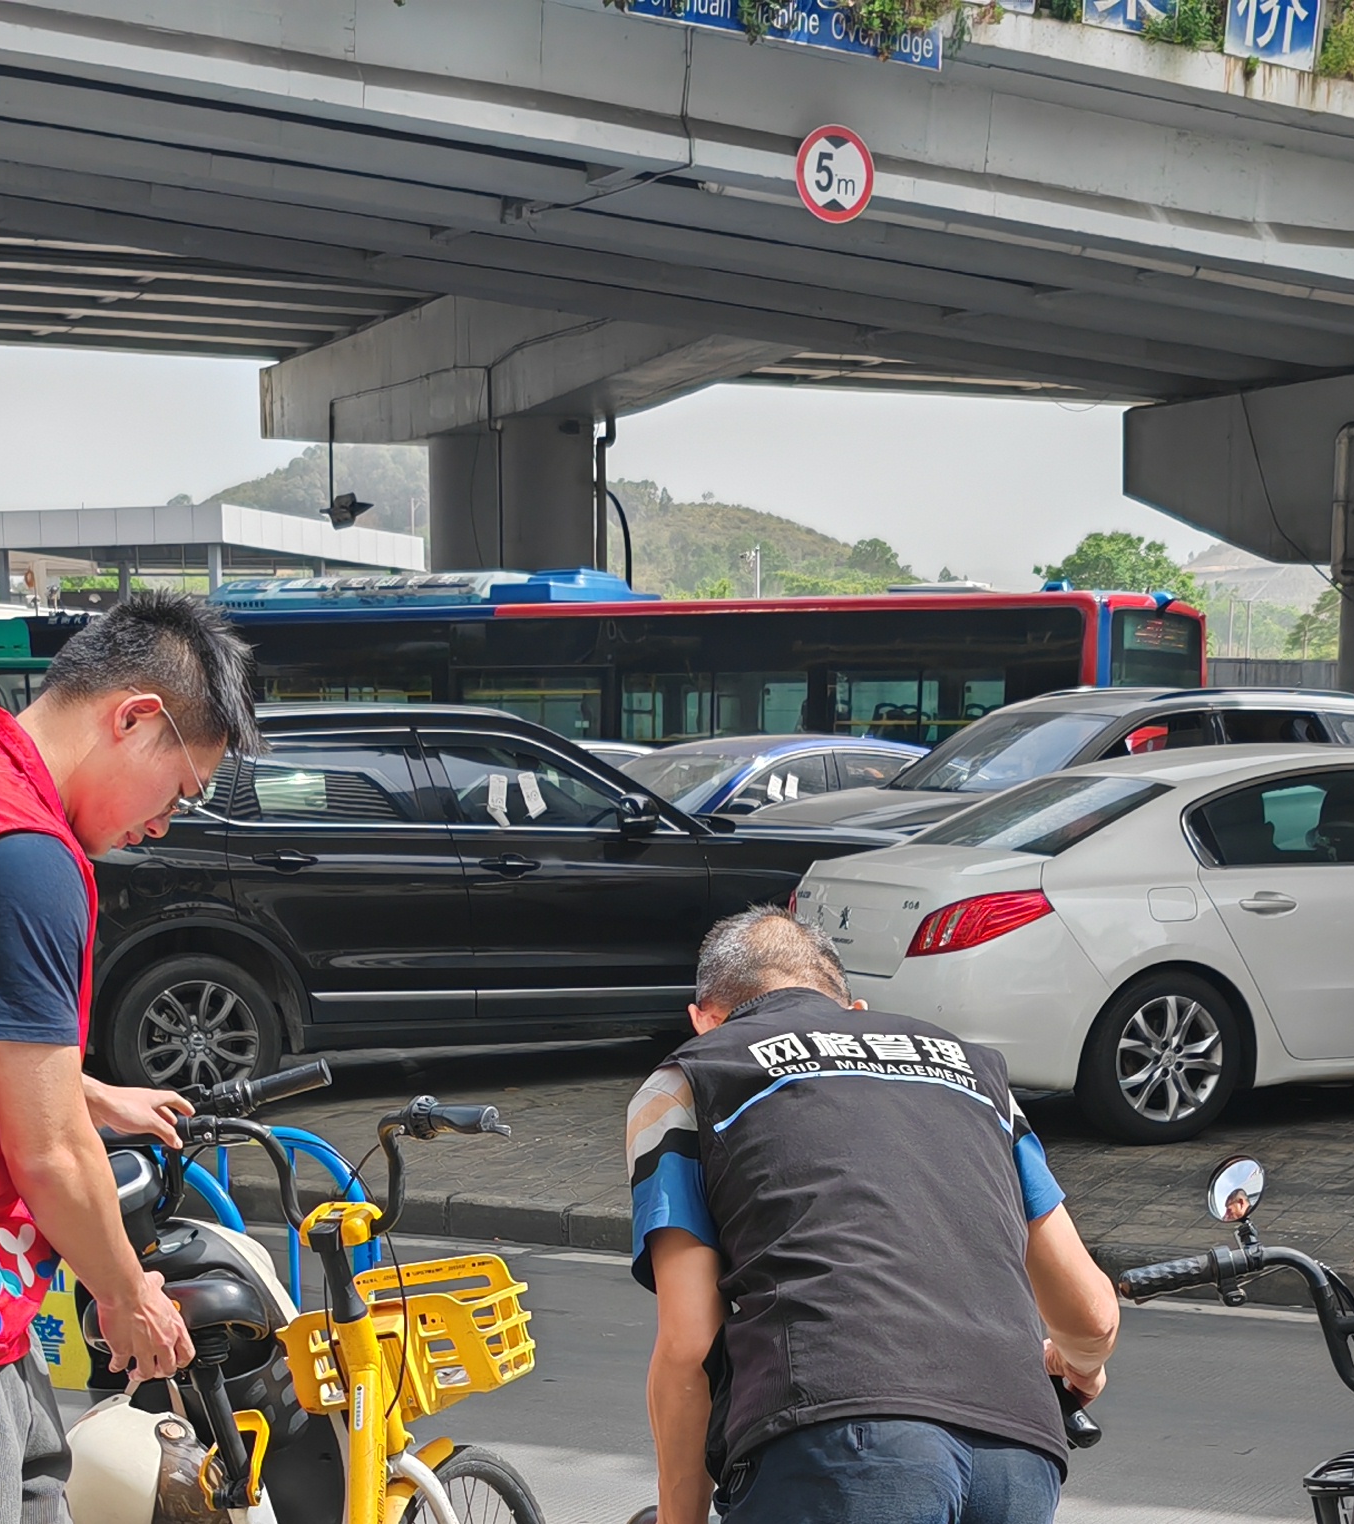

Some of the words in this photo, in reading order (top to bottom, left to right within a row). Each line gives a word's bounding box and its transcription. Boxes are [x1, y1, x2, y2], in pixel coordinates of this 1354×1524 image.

[748, 1031, 974, 1075] 网格管理
[767, 1061, 821, 1077] GRID
[835, 1059, 978, 1091] MANAGEMENT
